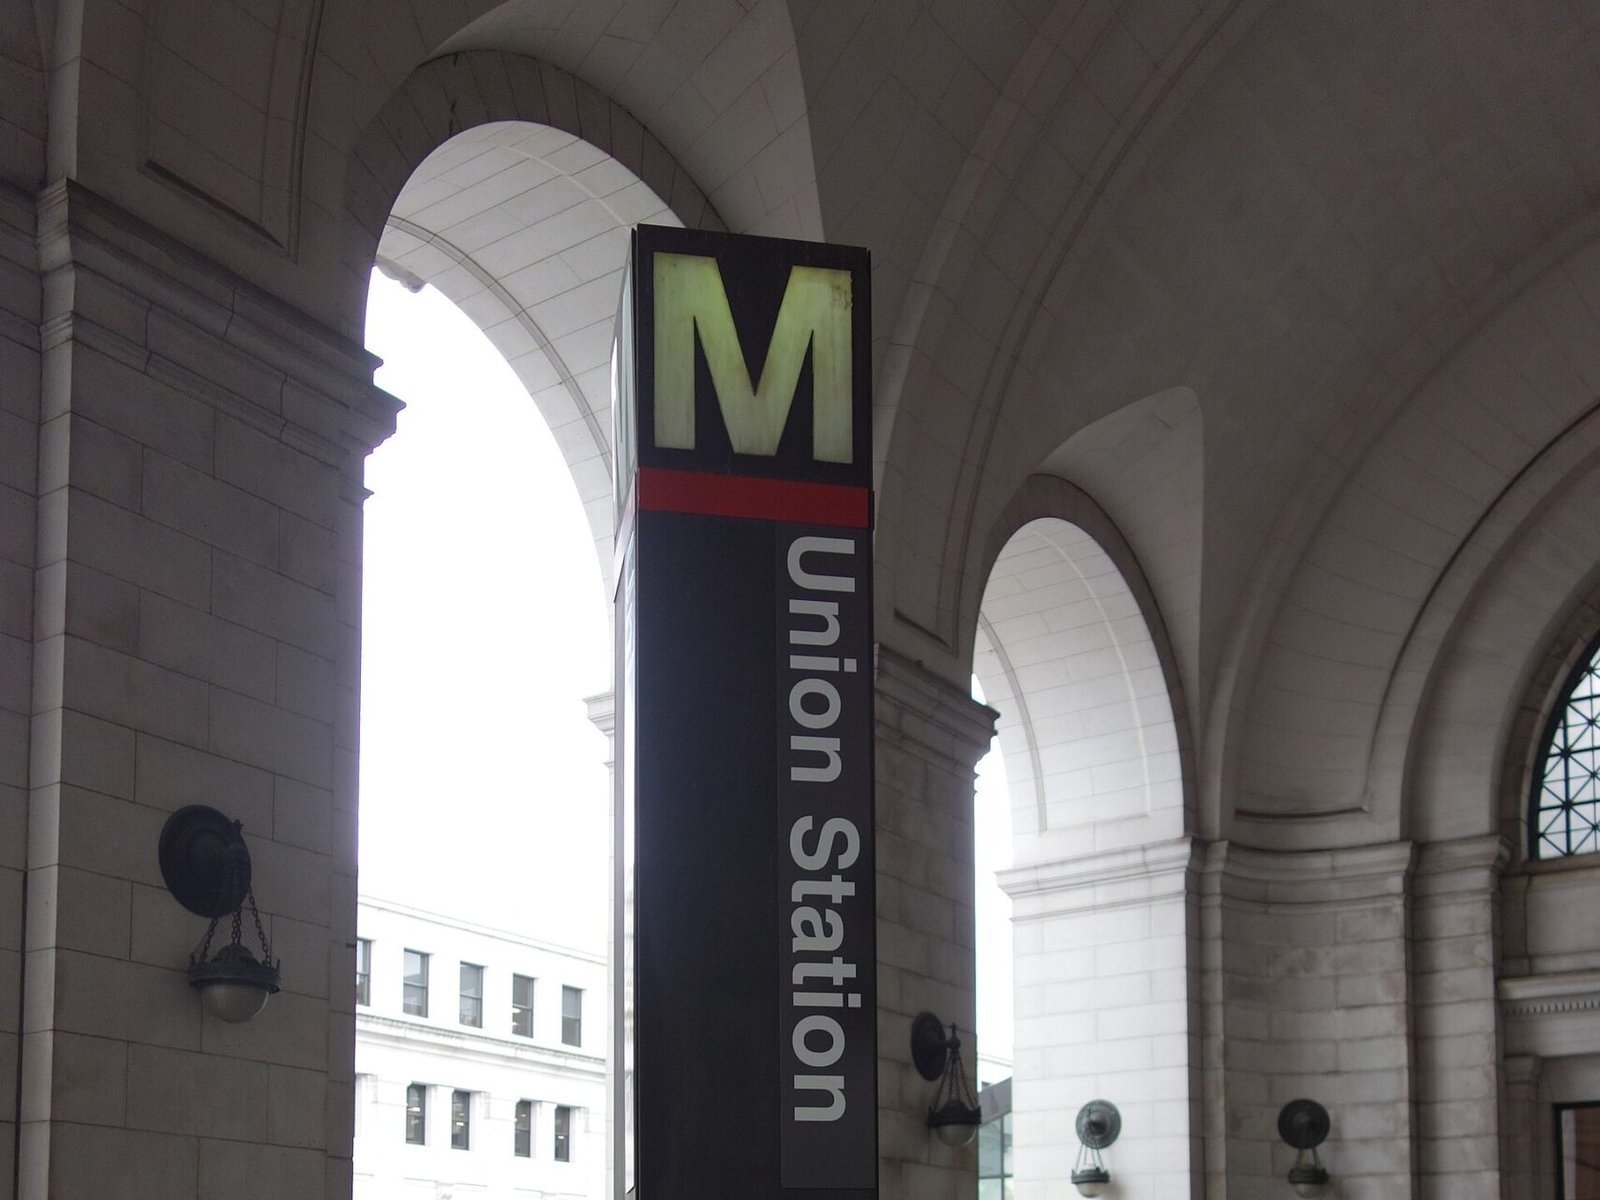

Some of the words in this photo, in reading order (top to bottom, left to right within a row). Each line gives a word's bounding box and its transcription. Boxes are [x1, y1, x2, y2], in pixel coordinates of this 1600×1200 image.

[653, 252, 853, 464] M
[787, 536, 857, 782] Union
[790, 815, 861, 1121] Station
